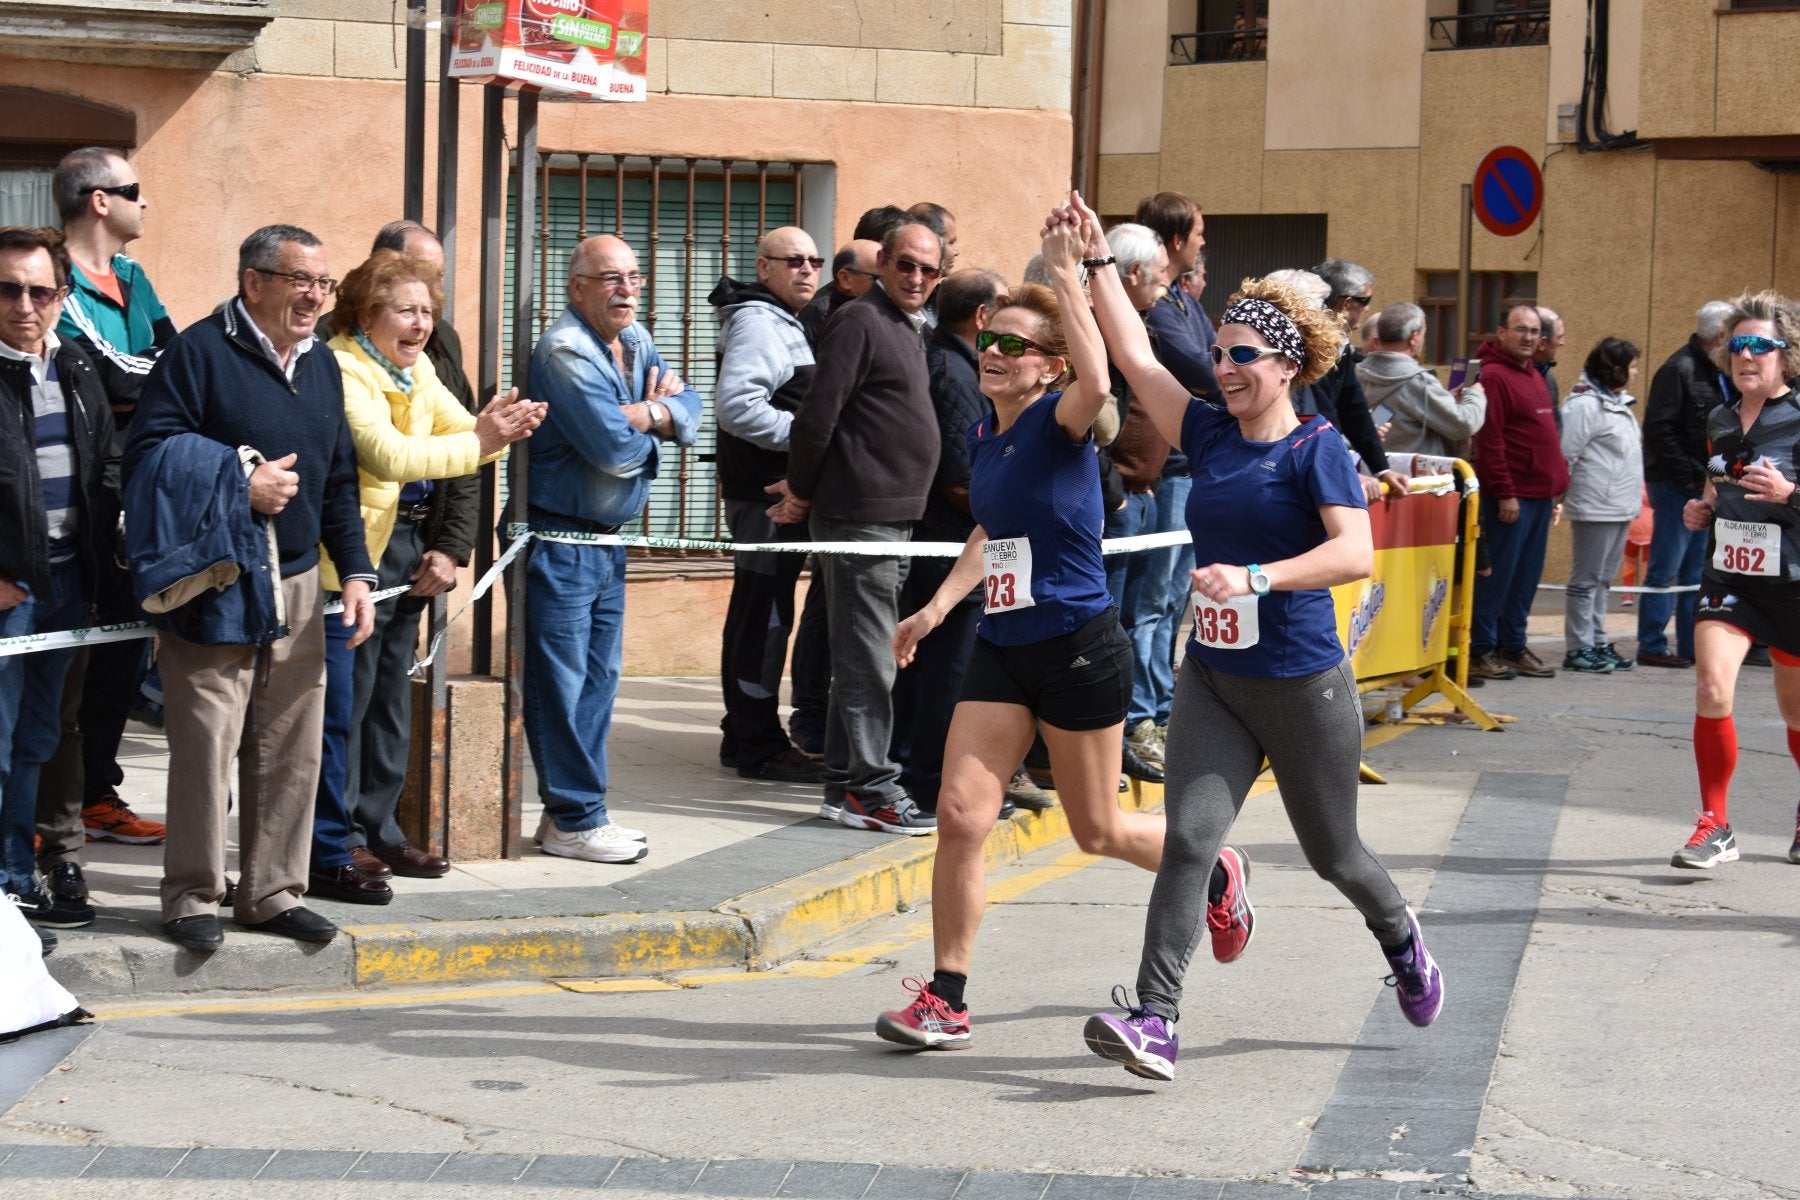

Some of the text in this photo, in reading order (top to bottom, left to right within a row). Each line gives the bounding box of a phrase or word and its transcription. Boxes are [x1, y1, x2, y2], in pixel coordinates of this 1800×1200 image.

[556, 18, 580, 38] SIN
[513, 60, 552, 77] FELICIDAD
[553, 70, 561, 79] DE
[571, 72, 598, 86] BUENA
[609, 82, 634, 94] BUENA
[1724, 521, 1767, 532] ALDEANUEVA
[999, 550, 1017, 560] EBRO
[1723, 544, 1765, 572] 362
[985, 573, 1015, 609] 23
[1196, 605, 1239, 644] 333
